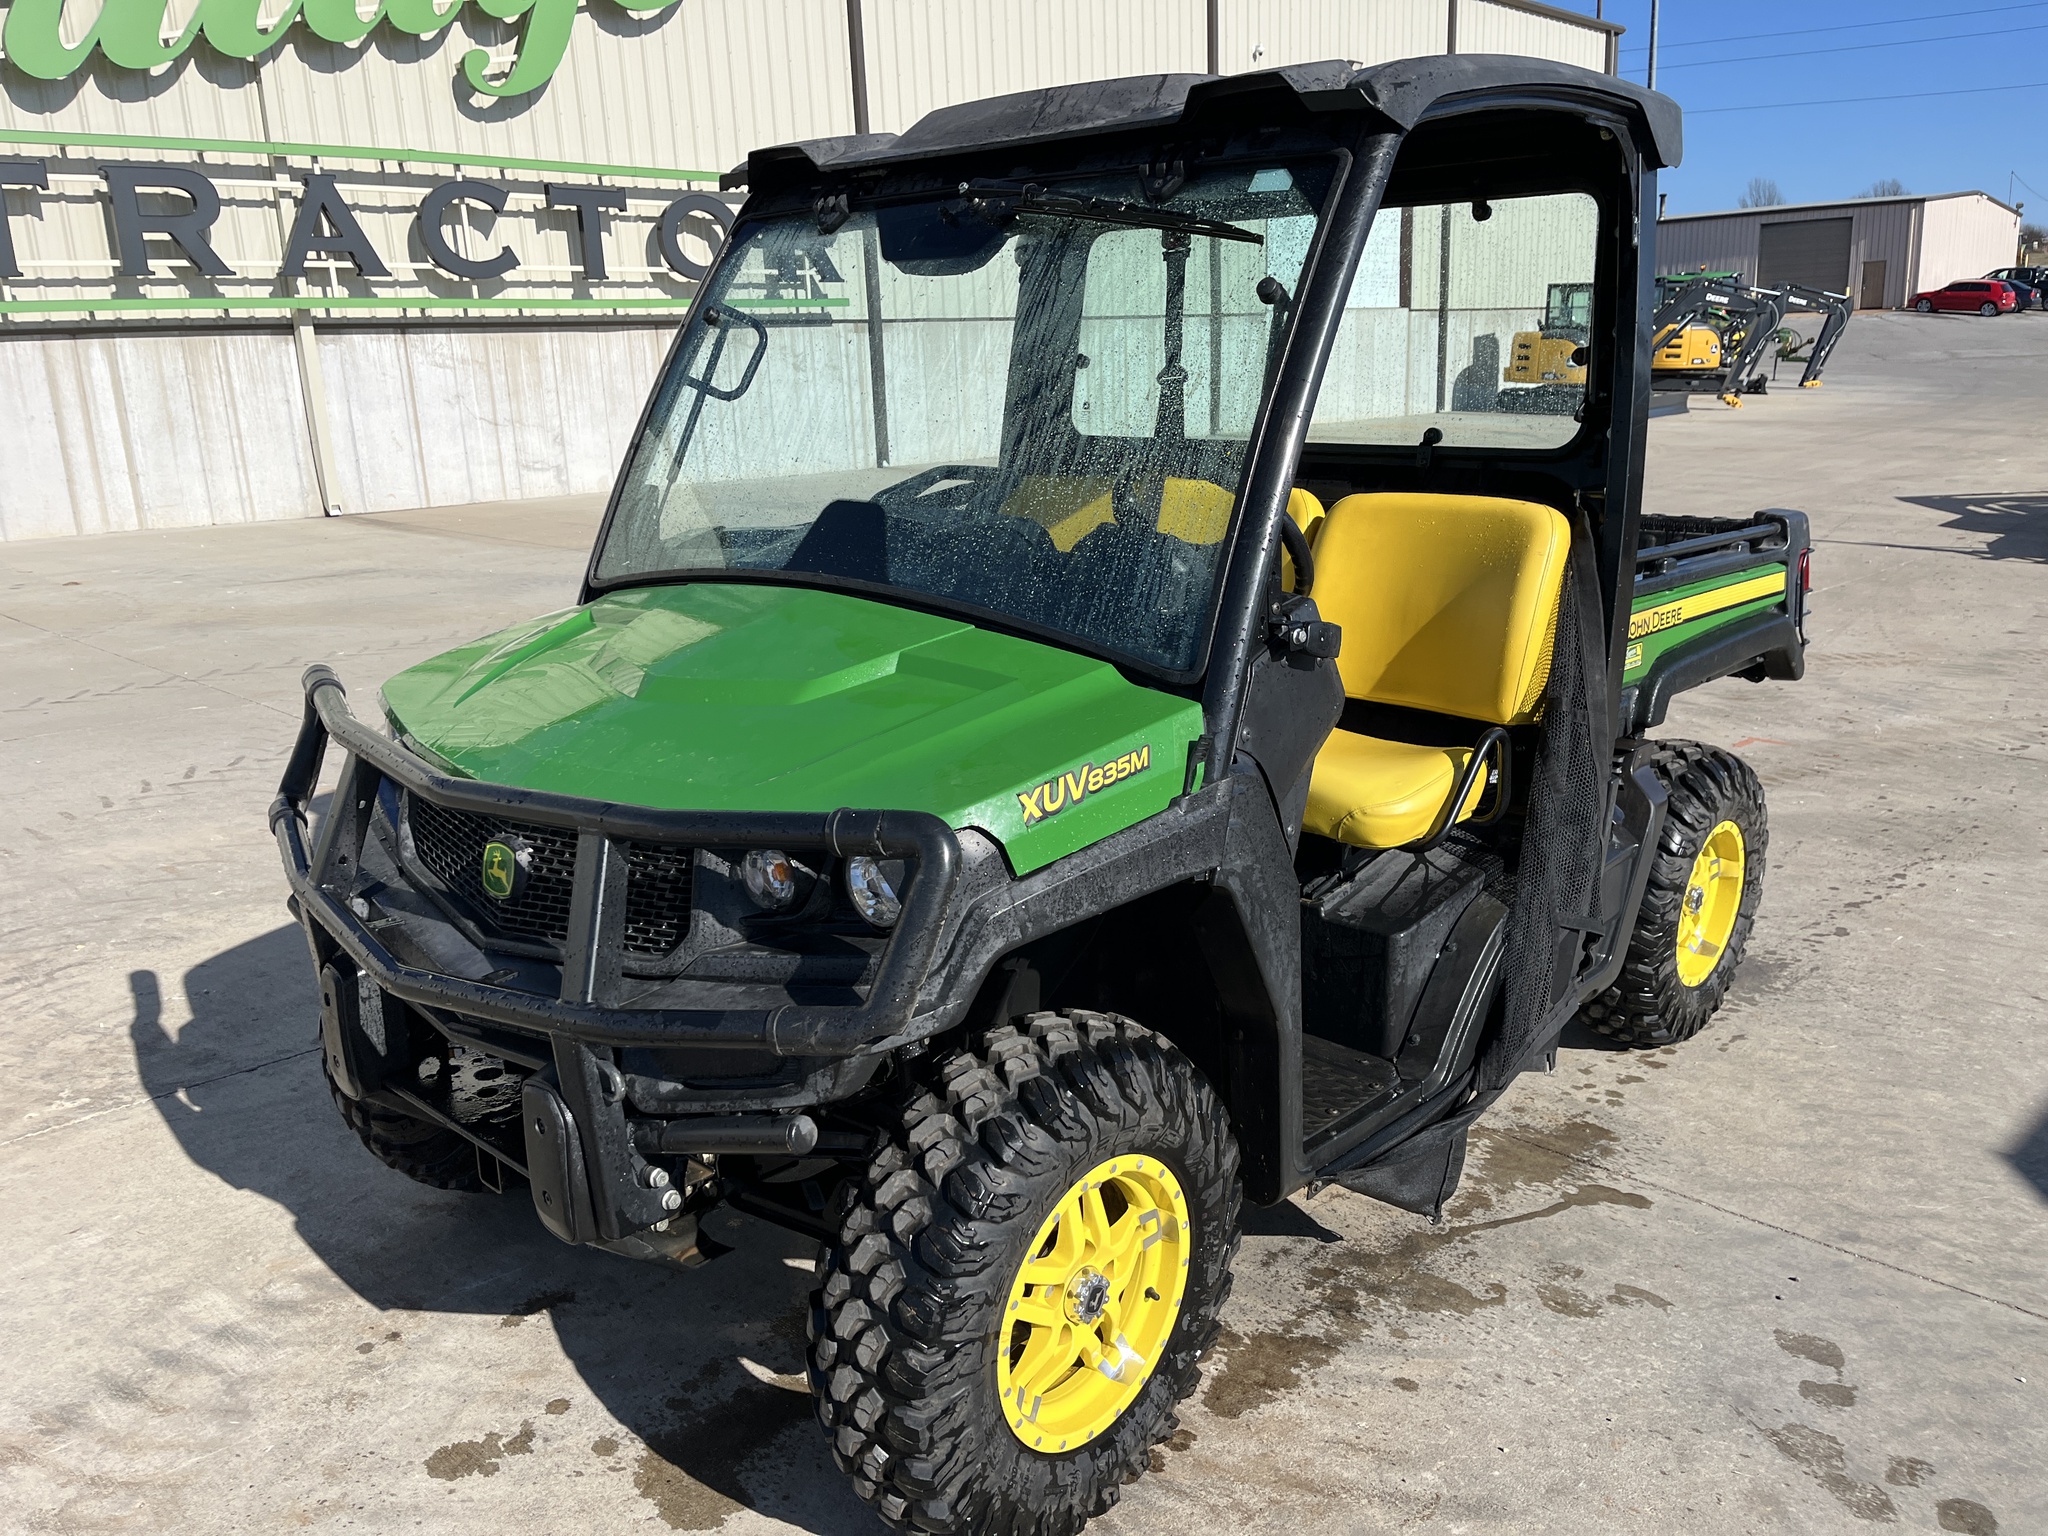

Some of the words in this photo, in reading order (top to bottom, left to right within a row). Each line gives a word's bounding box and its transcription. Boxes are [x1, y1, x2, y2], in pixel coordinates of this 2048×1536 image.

[1705, 292, 1730, 305] DEERE
[1788, 295, 1808, 306] DEERE
[1629, 617, 1650, 636] OHN
[1652, 607, 1682, 629] DEERE
[1018, 745, 1150, 824] XUV835M
